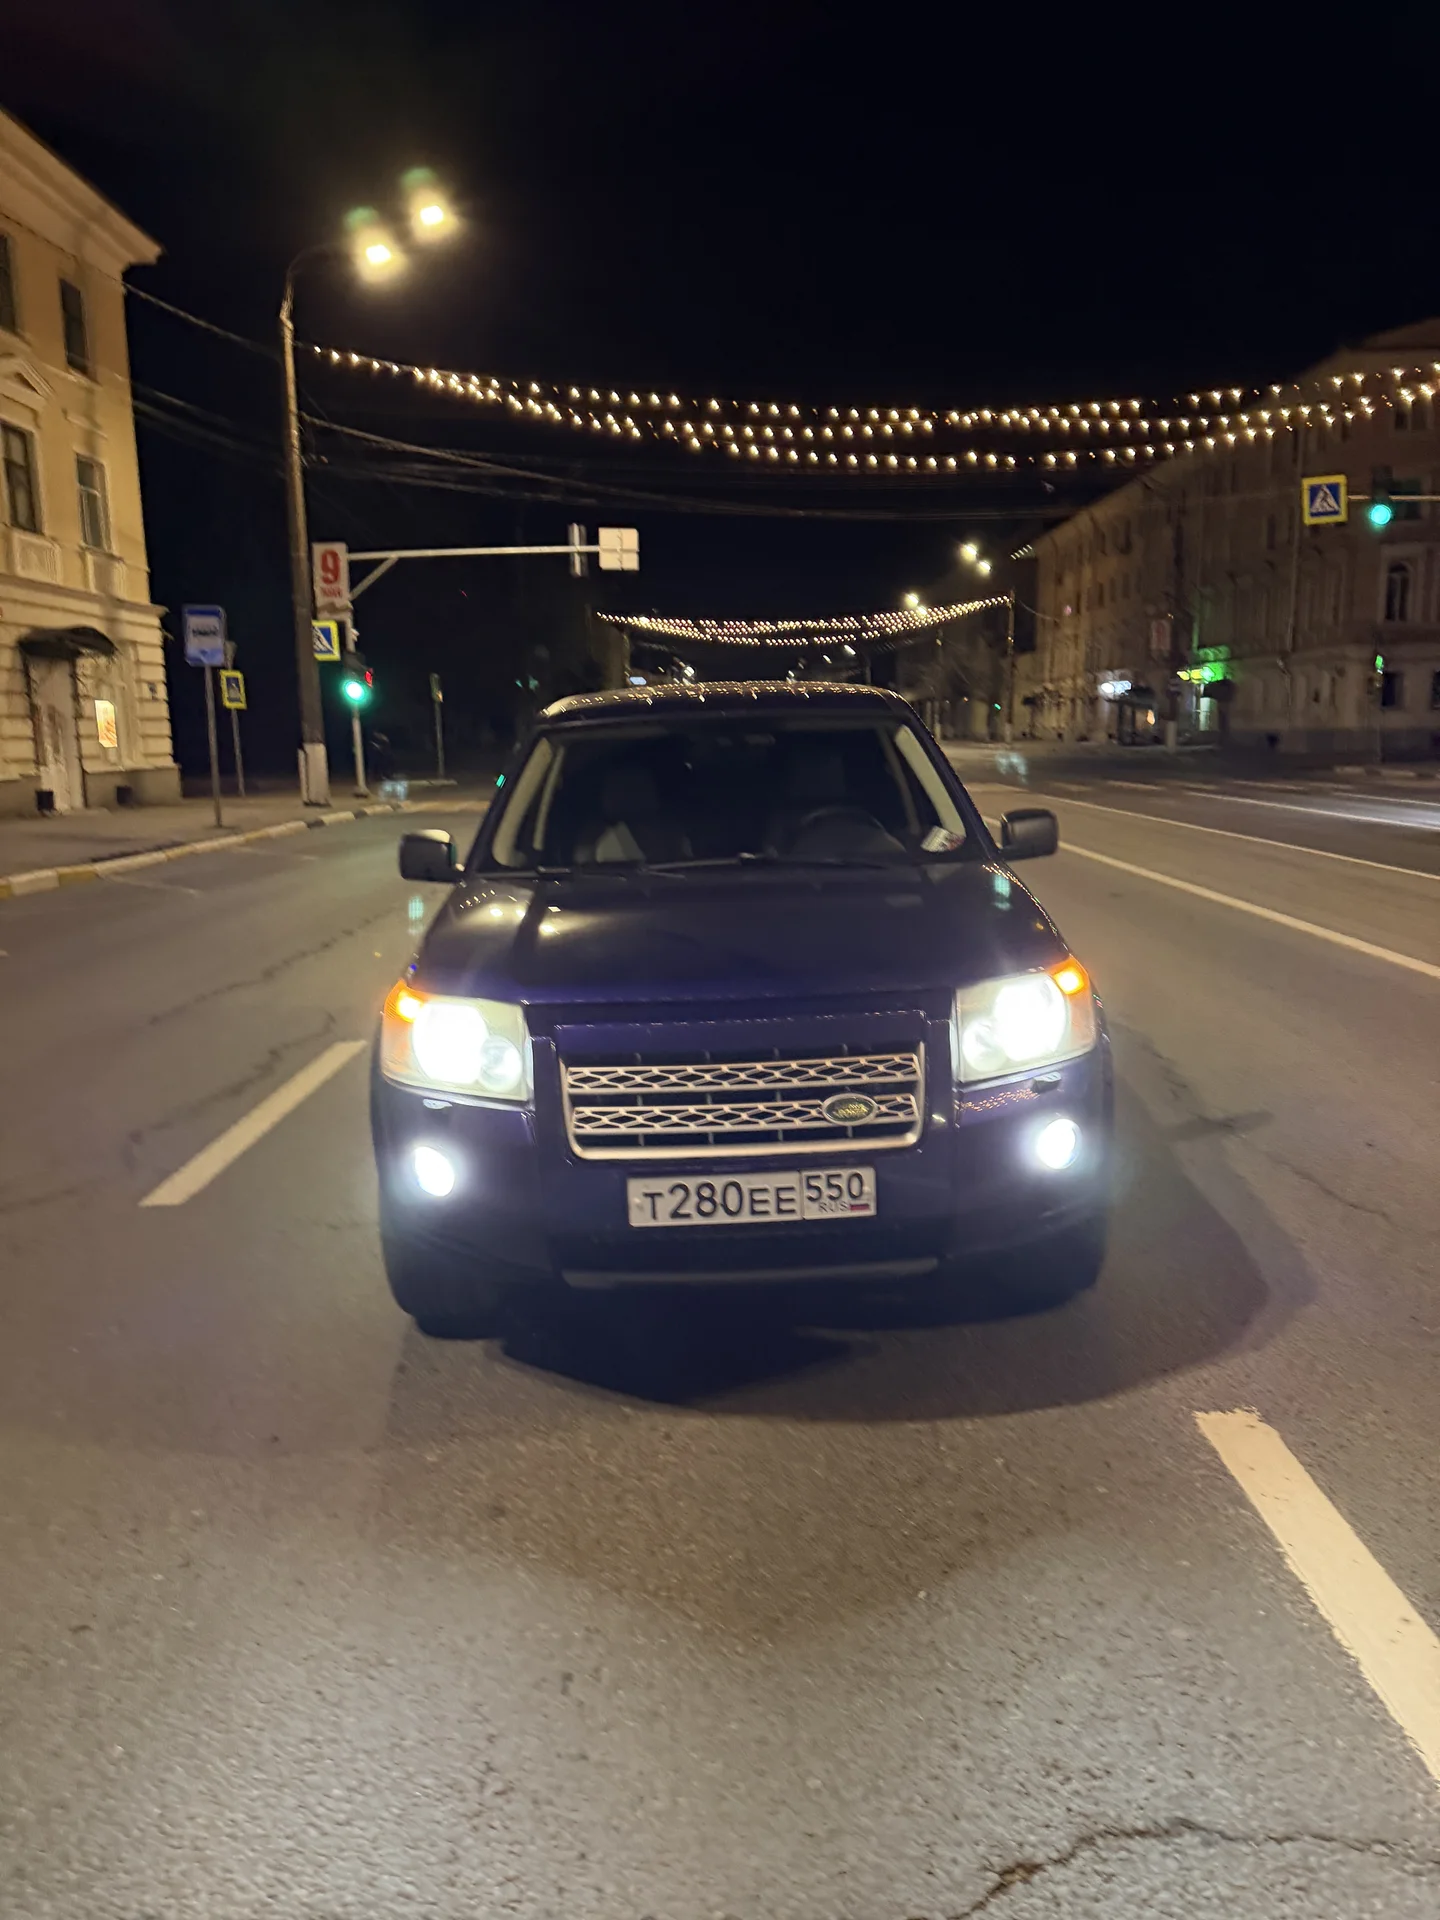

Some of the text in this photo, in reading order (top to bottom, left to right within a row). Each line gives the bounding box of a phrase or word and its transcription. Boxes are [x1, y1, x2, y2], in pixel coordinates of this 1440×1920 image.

[320, 549, 341, 585] 9
[805, 1172, 865, 1202] 550
[817, 1201, 849, 1213] RUS
